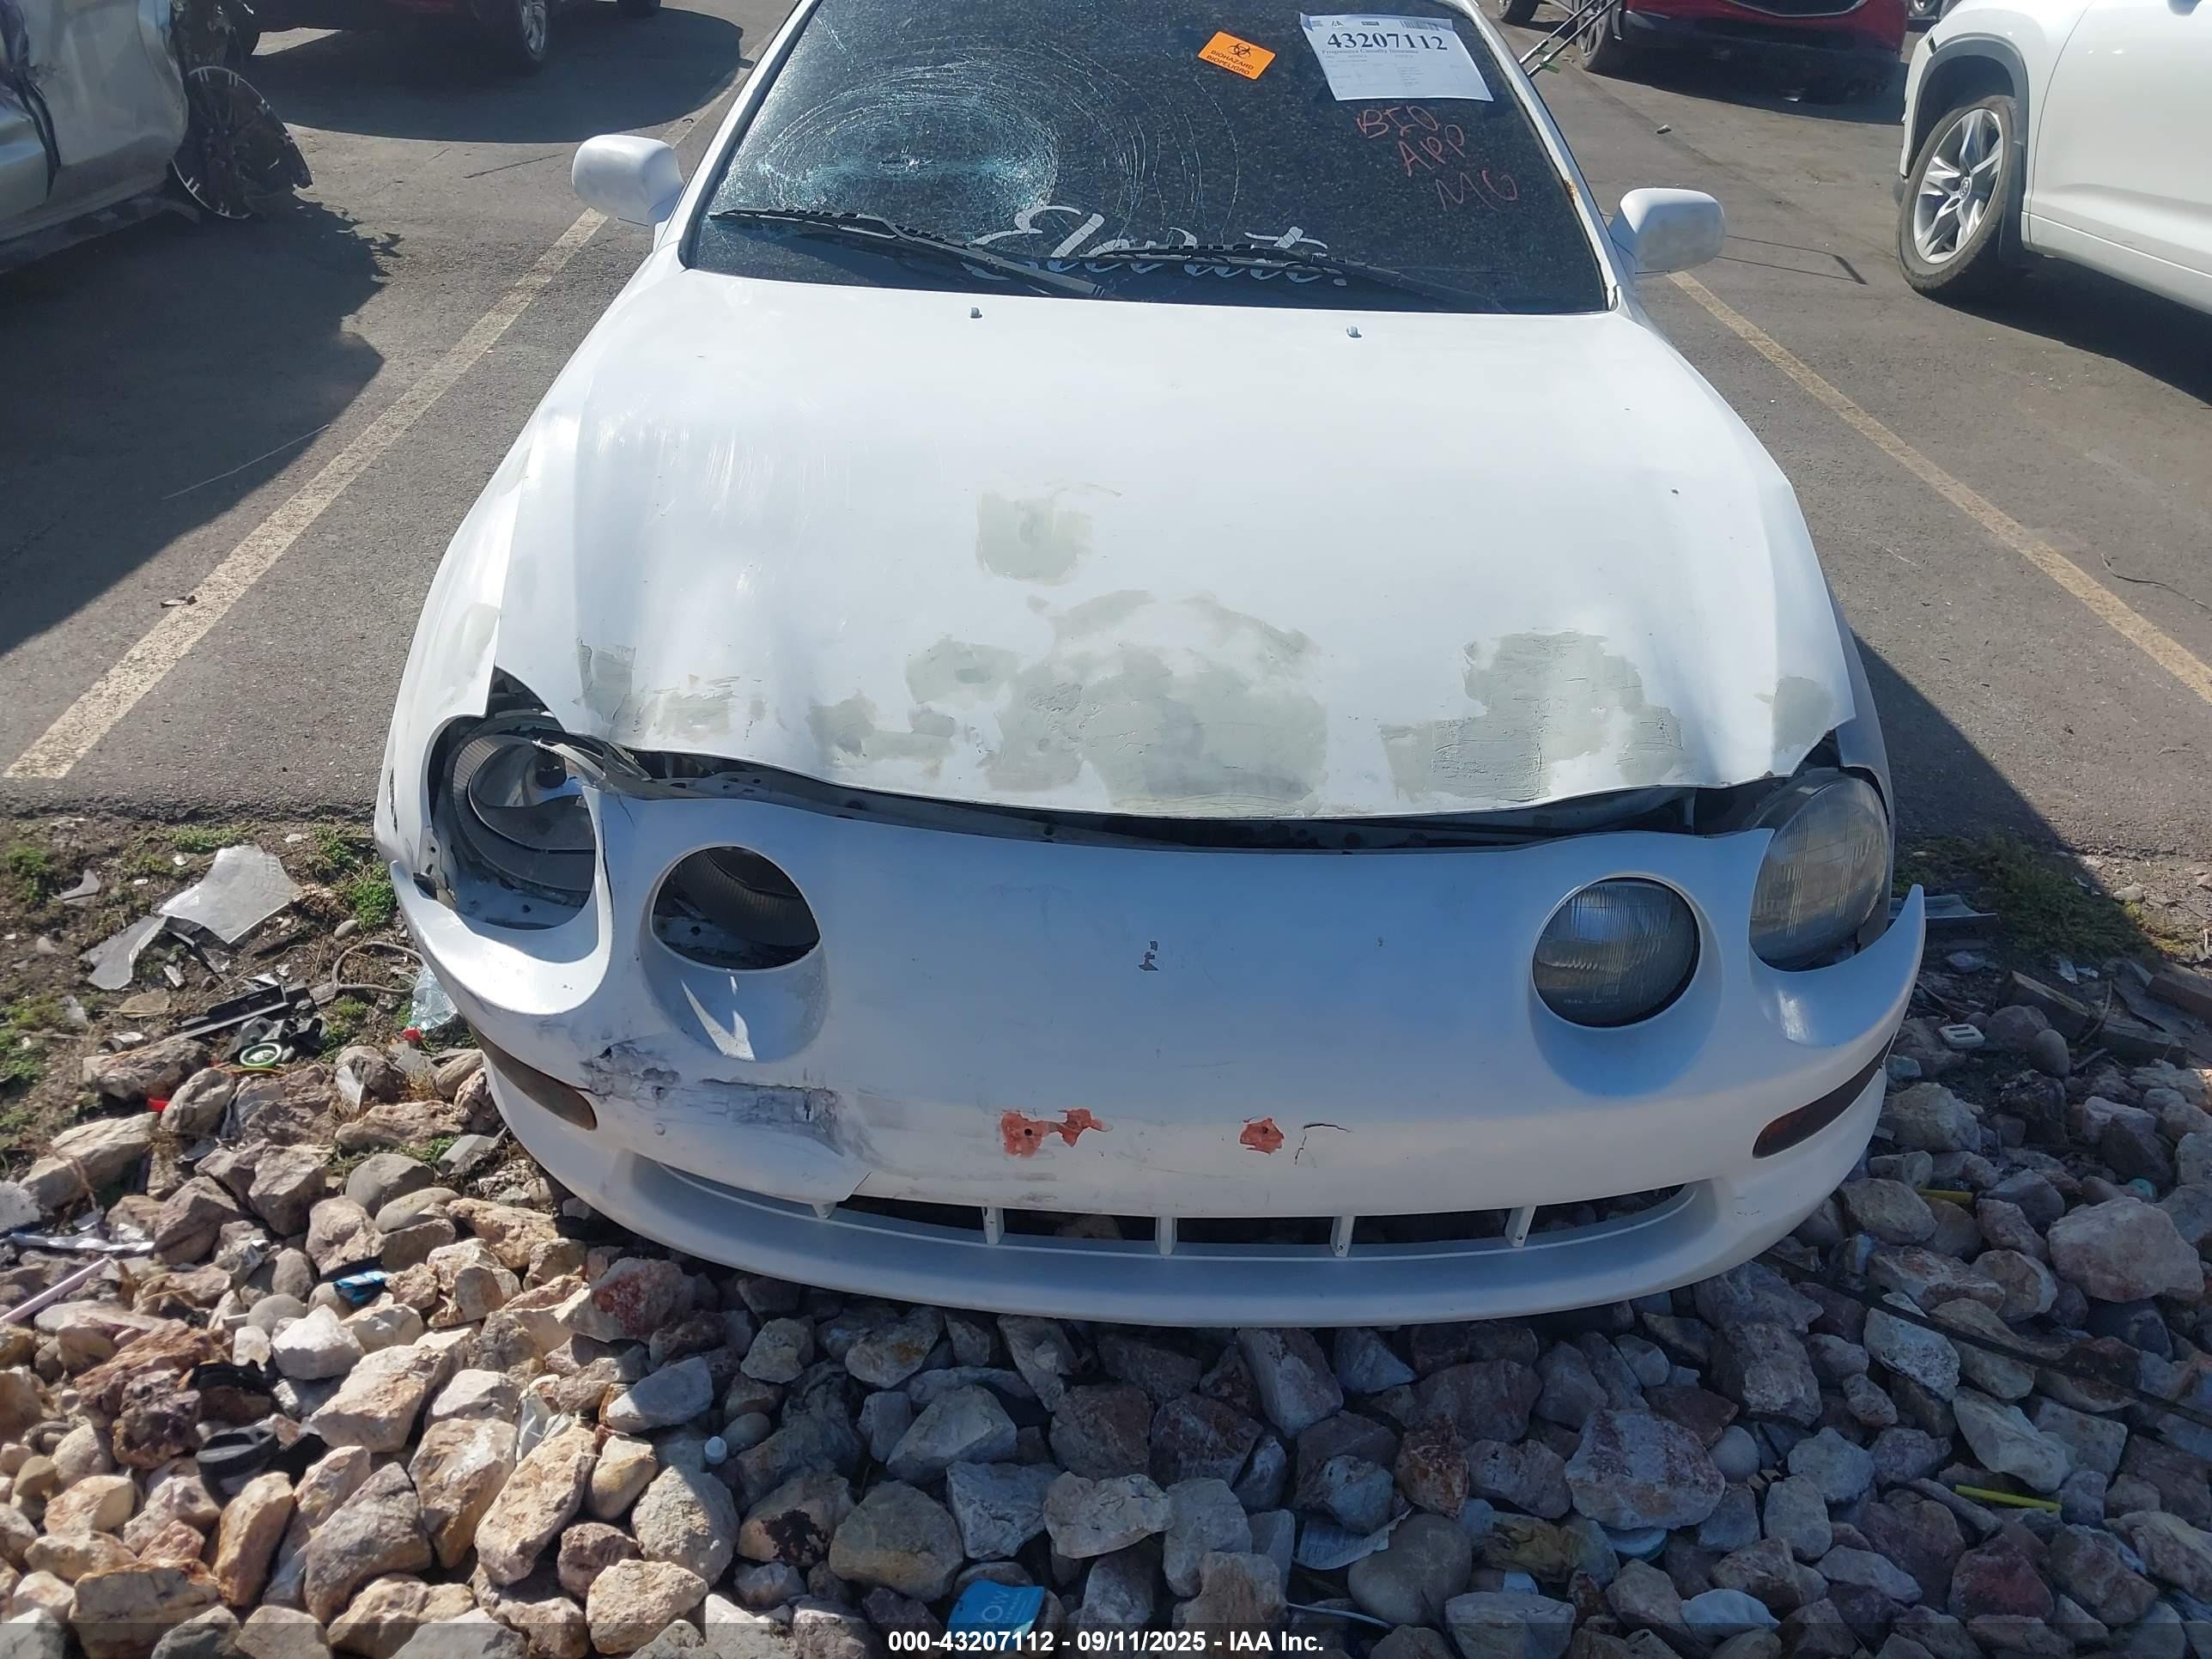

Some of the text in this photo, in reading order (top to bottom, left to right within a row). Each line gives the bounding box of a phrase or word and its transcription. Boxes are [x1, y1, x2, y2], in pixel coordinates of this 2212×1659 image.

[1328, 33, 1448, 51] 43207112
[1206, 55, 1250, 75] BIOPELIGRO
[1211, 50, 1255, 70] BIOHAZARD
[1398, 125, 1465, 177] APP
